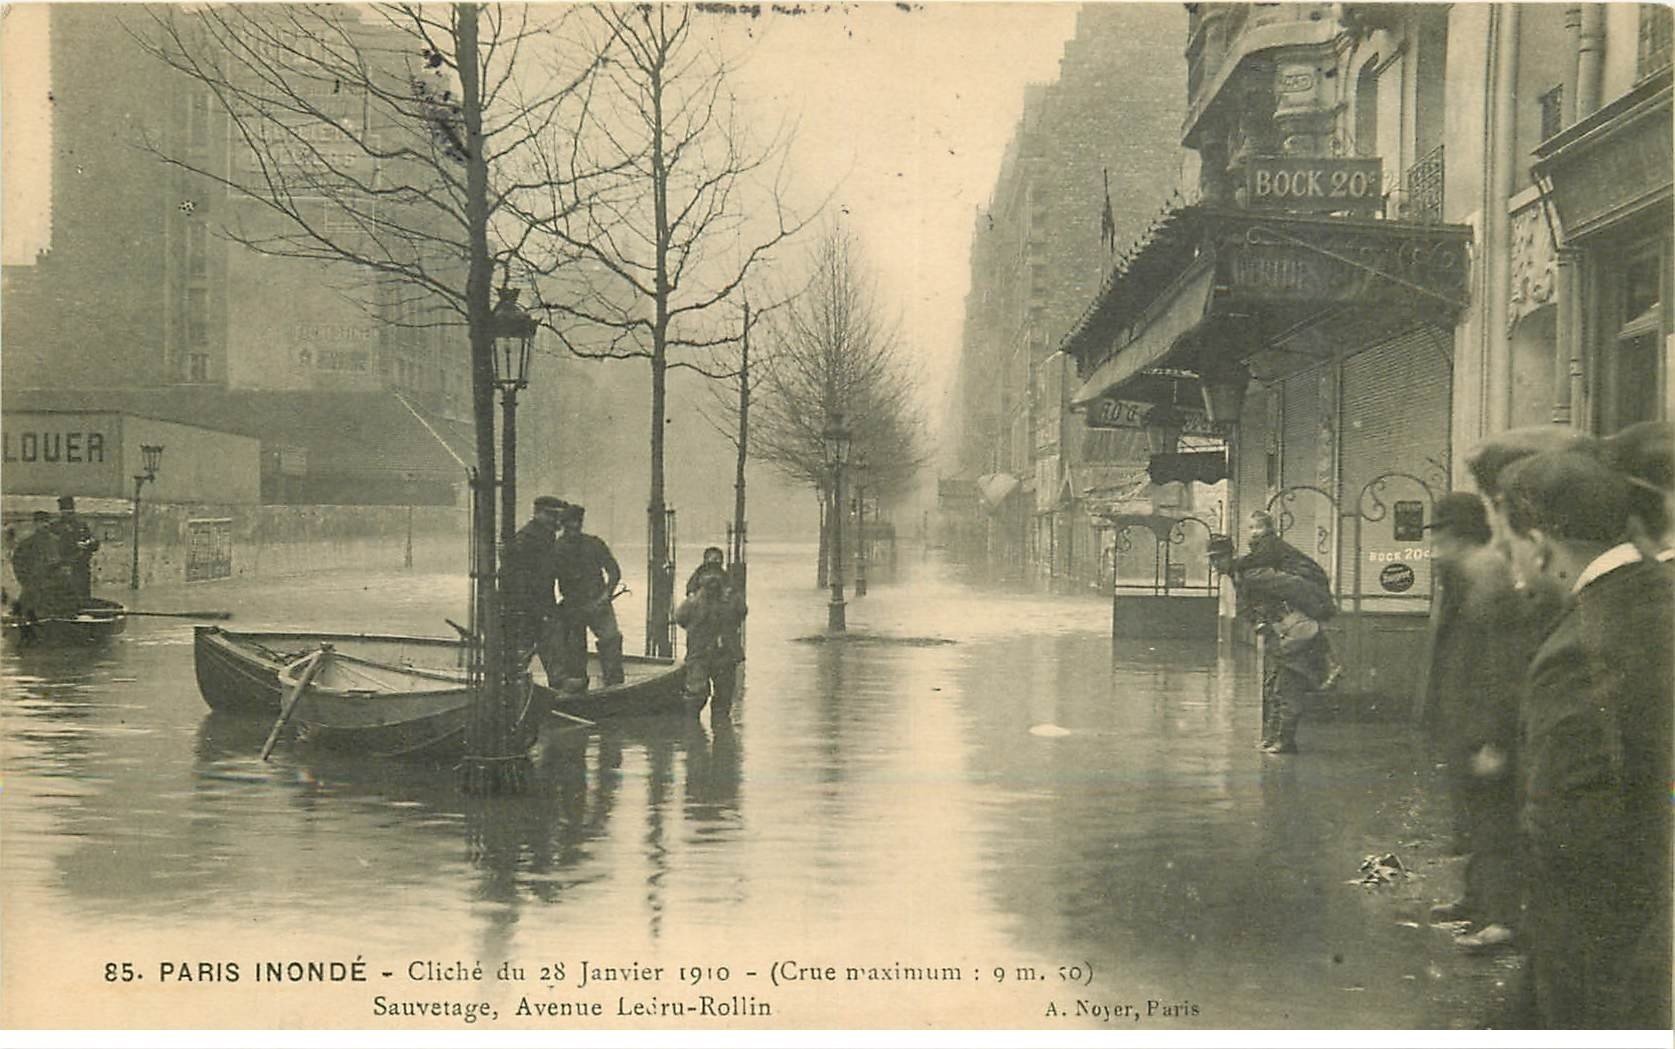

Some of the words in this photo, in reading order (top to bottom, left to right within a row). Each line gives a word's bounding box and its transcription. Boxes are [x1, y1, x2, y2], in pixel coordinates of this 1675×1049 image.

[1255, 169, 1324, 198] BOCK
[3, 432, 104, 463] LOUER
[1369, 551, 1402, 562] BOCK
